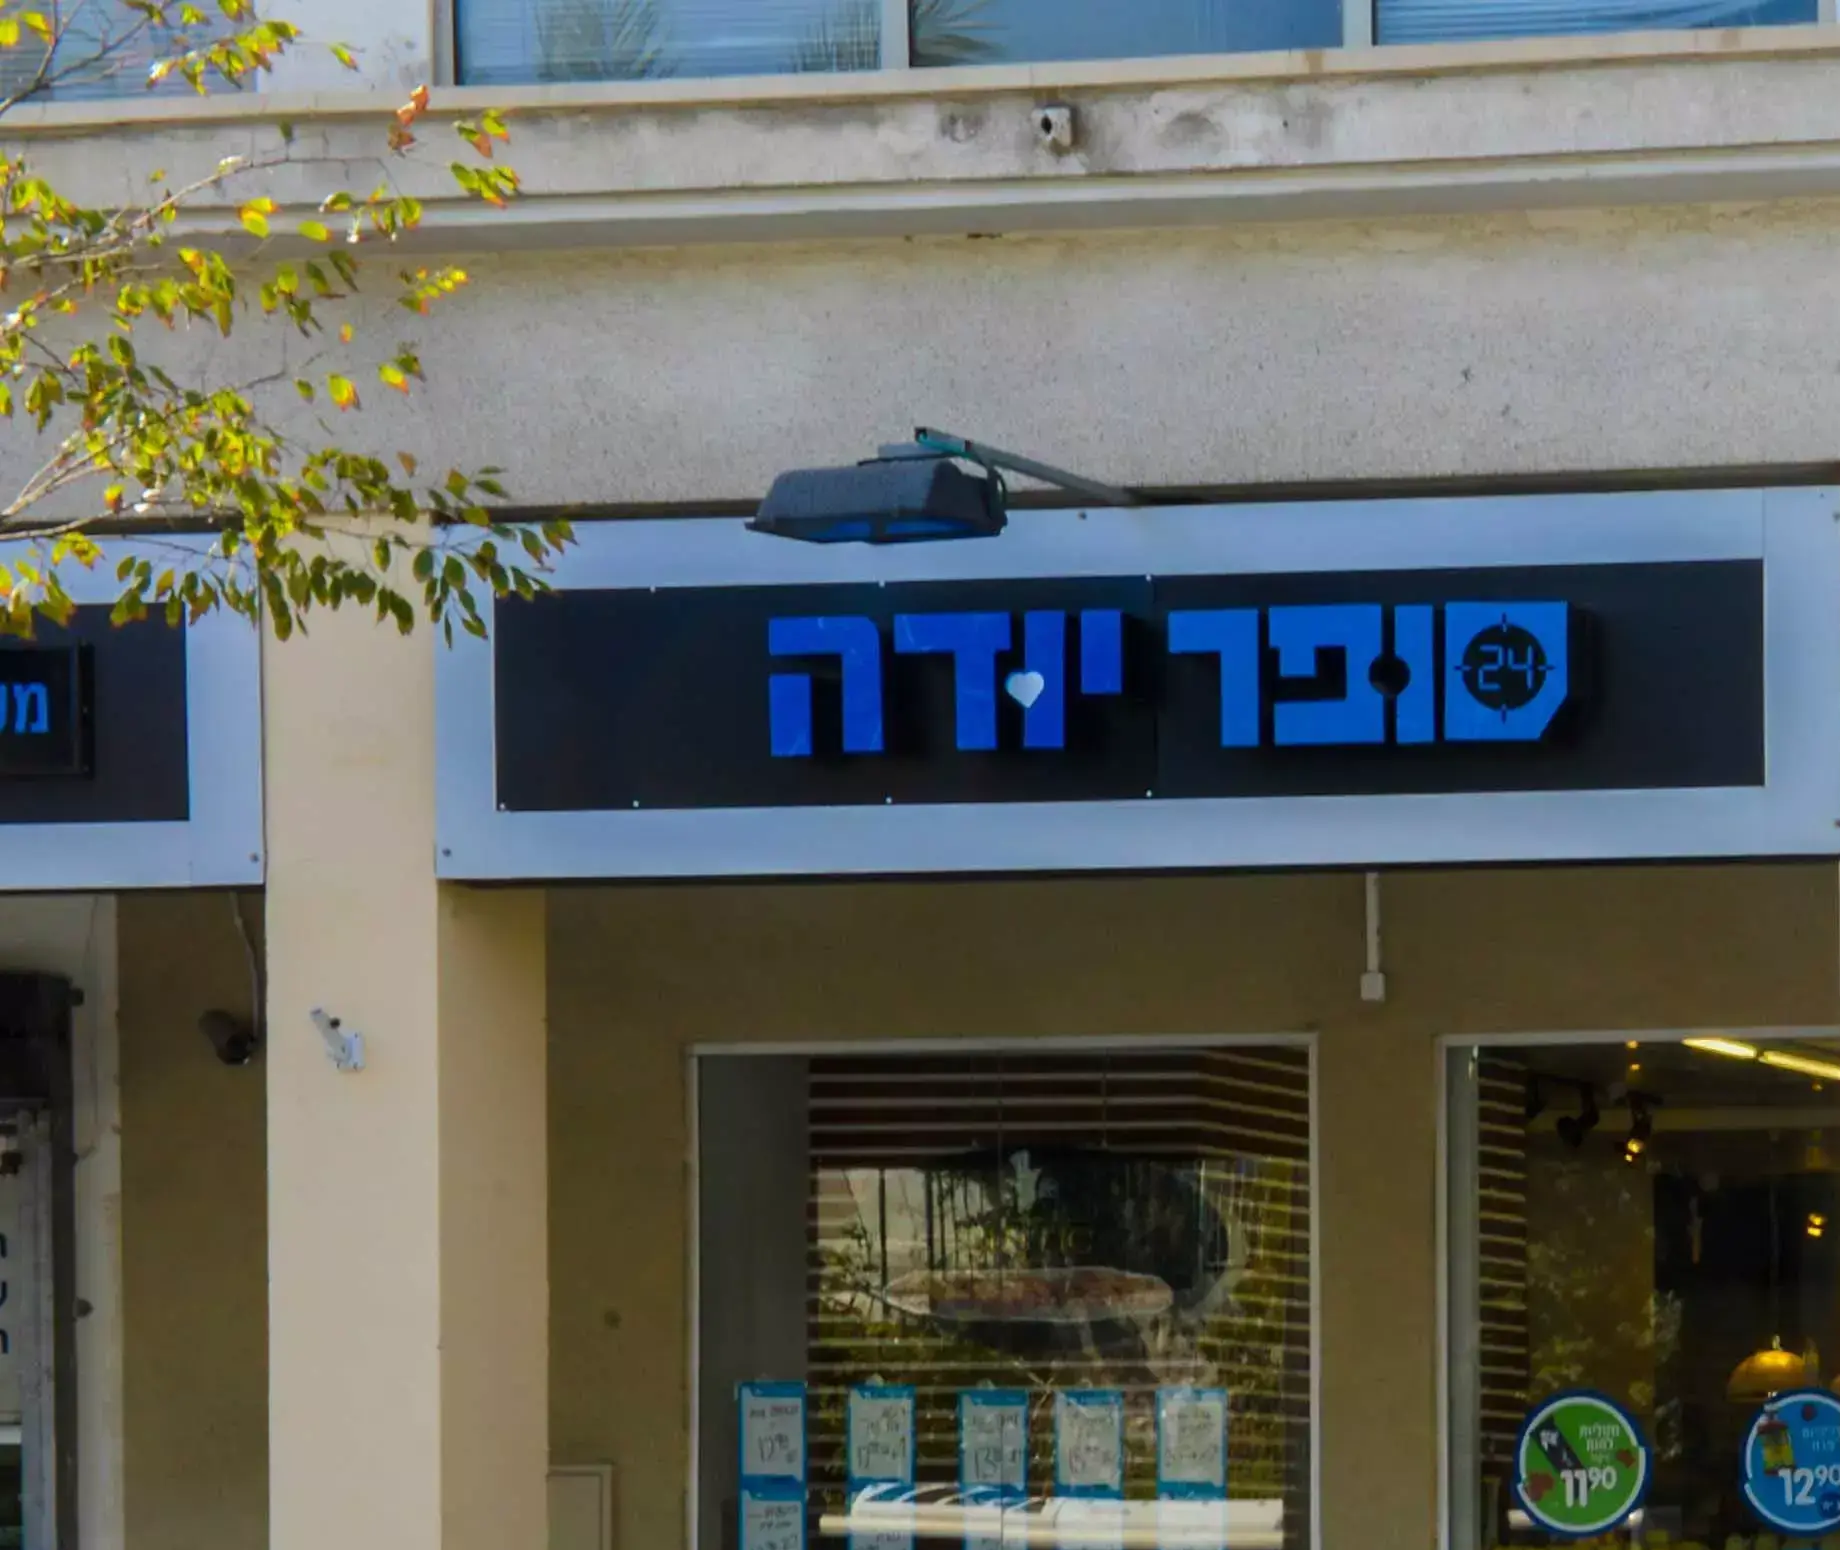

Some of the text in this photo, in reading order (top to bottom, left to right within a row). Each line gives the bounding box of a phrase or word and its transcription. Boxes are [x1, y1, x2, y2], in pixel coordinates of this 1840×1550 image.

[767, 600, 1569, 758] סופר יודה
[1475, 644, 1536, 693] 24
